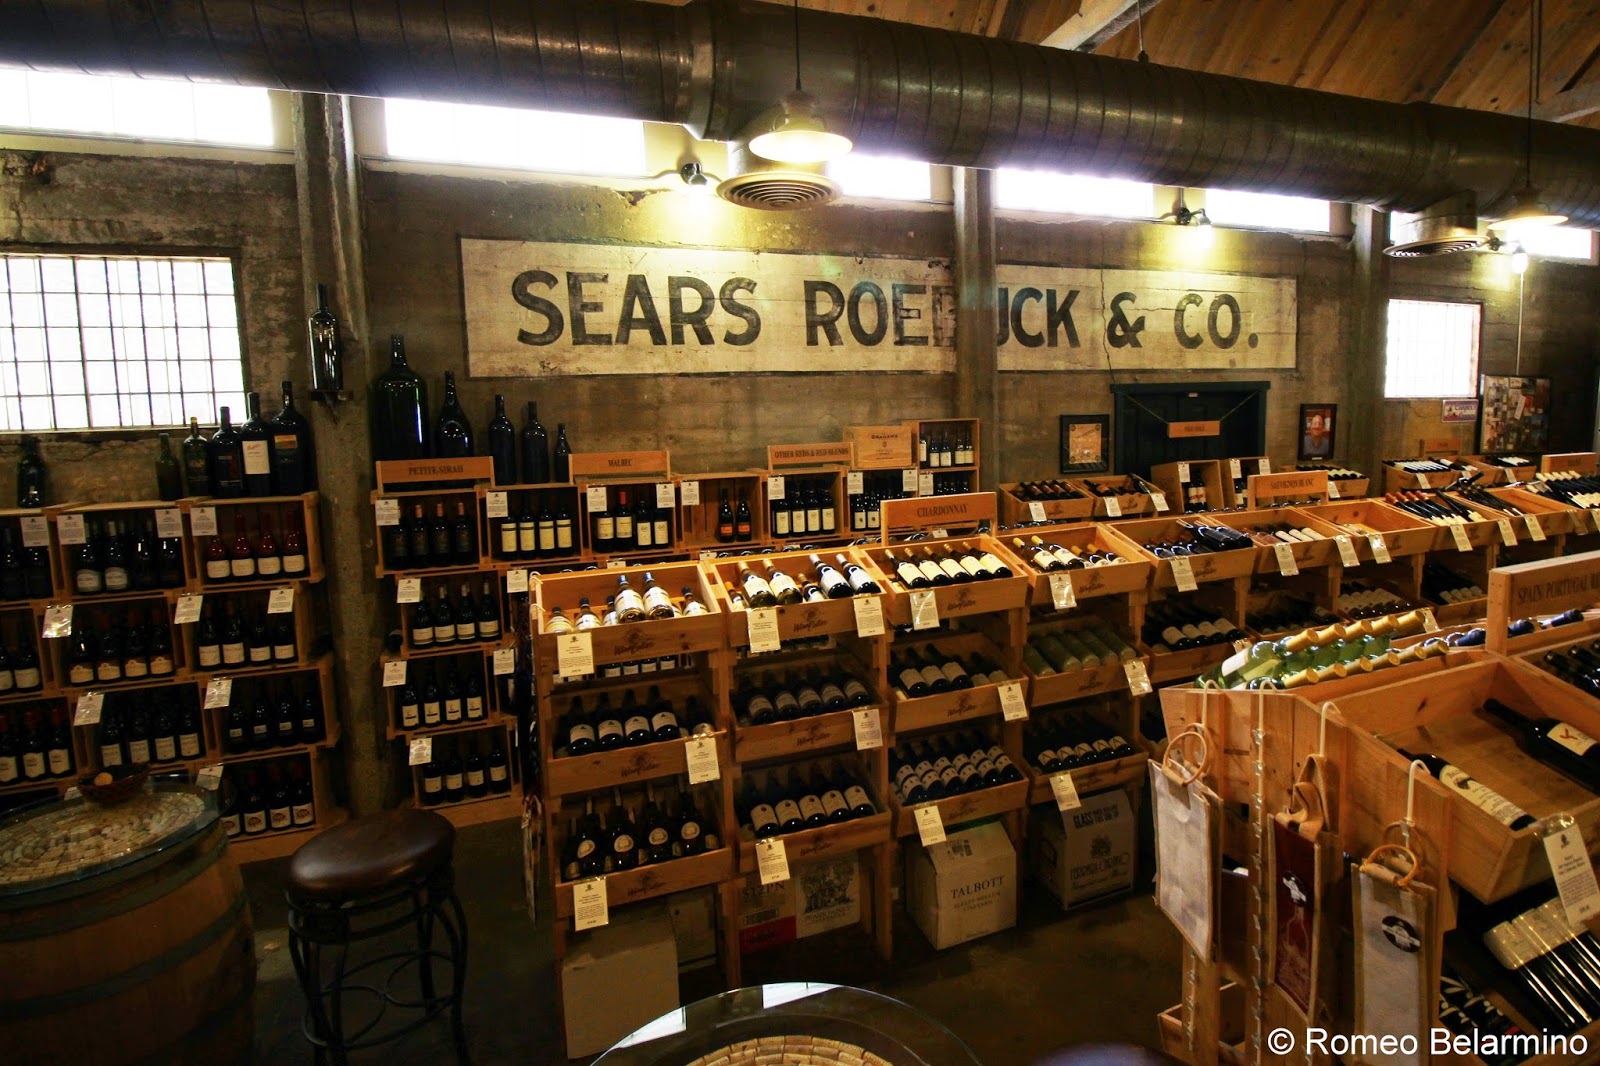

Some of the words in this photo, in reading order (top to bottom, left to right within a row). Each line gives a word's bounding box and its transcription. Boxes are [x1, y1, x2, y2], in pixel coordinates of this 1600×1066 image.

[512, 270, 762, 346] SEARS
[1107, 292, 1146, 348] &
[1174, 293, 1259, 349] CO.
[774, 450, 795, 459] OTHER
[795, 449, 810, 458] REDS
[827, 447, 849, 456] BLENDS
[608, 458, 633, 467] MALBEC
[917, 503, 968, 518] CHARDONNAY
[950, 875, 1005, 900] TALBOTT
